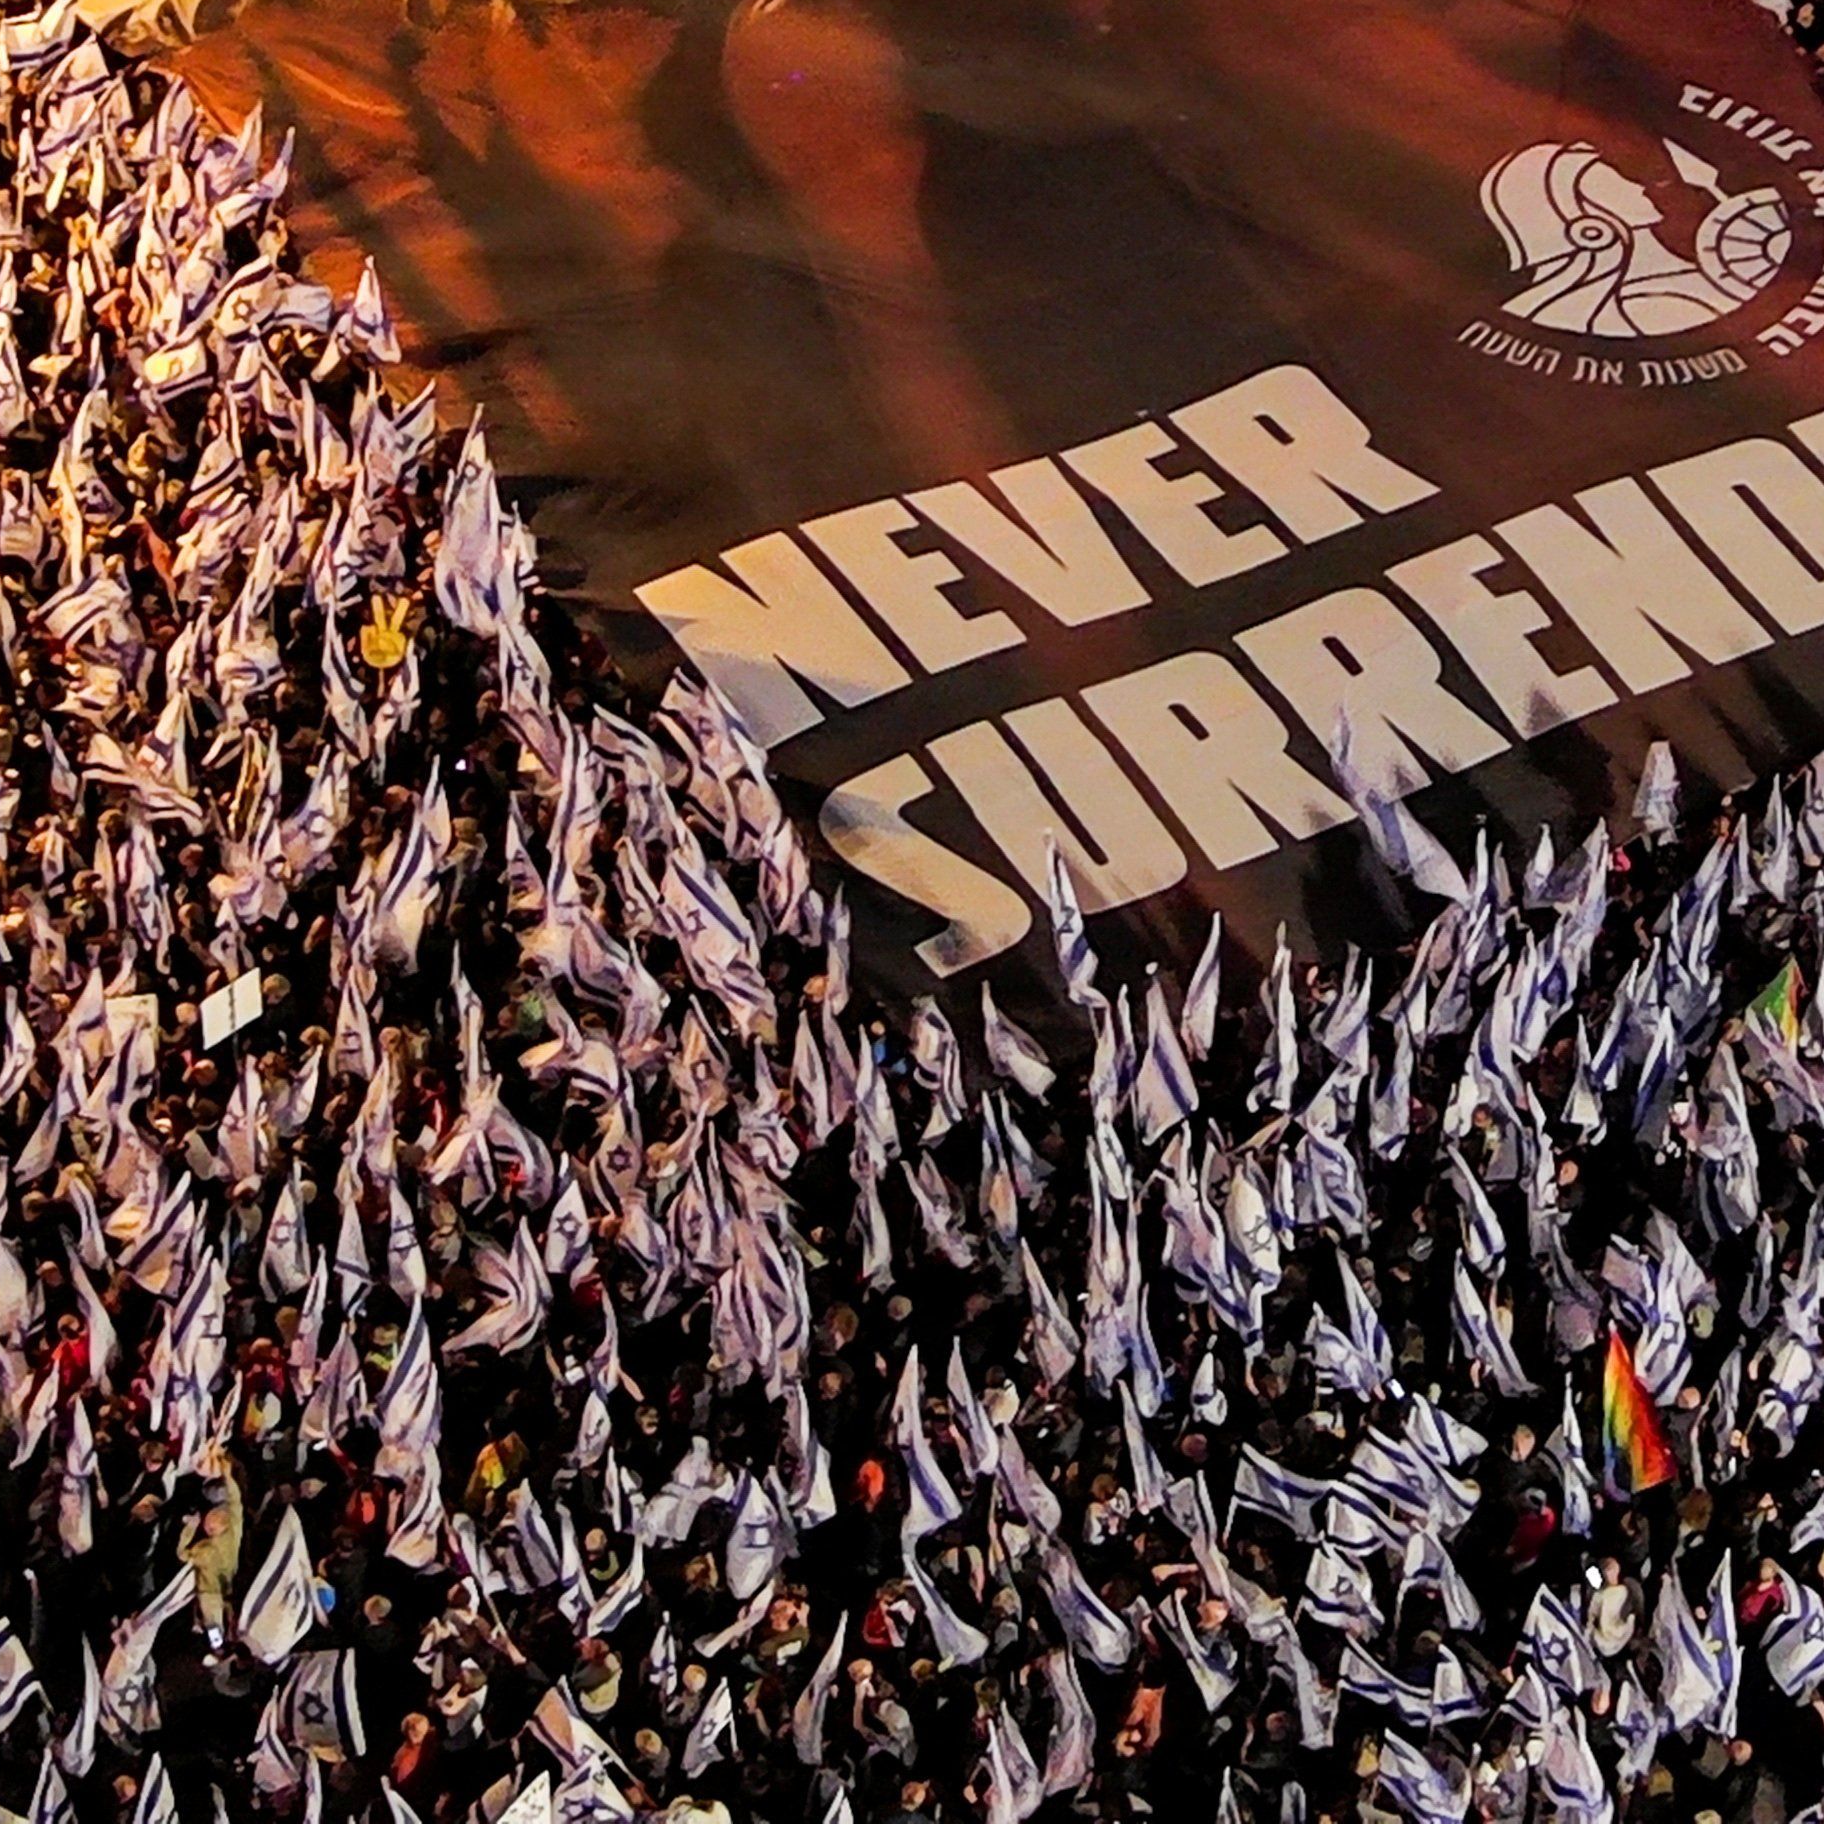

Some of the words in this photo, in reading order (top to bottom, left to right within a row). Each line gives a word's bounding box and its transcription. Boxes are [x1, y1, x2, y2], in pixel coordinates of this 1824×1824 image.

[1678, 83, 1812, 161] בונות
[1457, 321, 1560, 375] השטח
[1573, 357, 1623, 385] את
[1639, 348, 1747, 387] משנות
[633, 364, 1441, 750] NEVER
